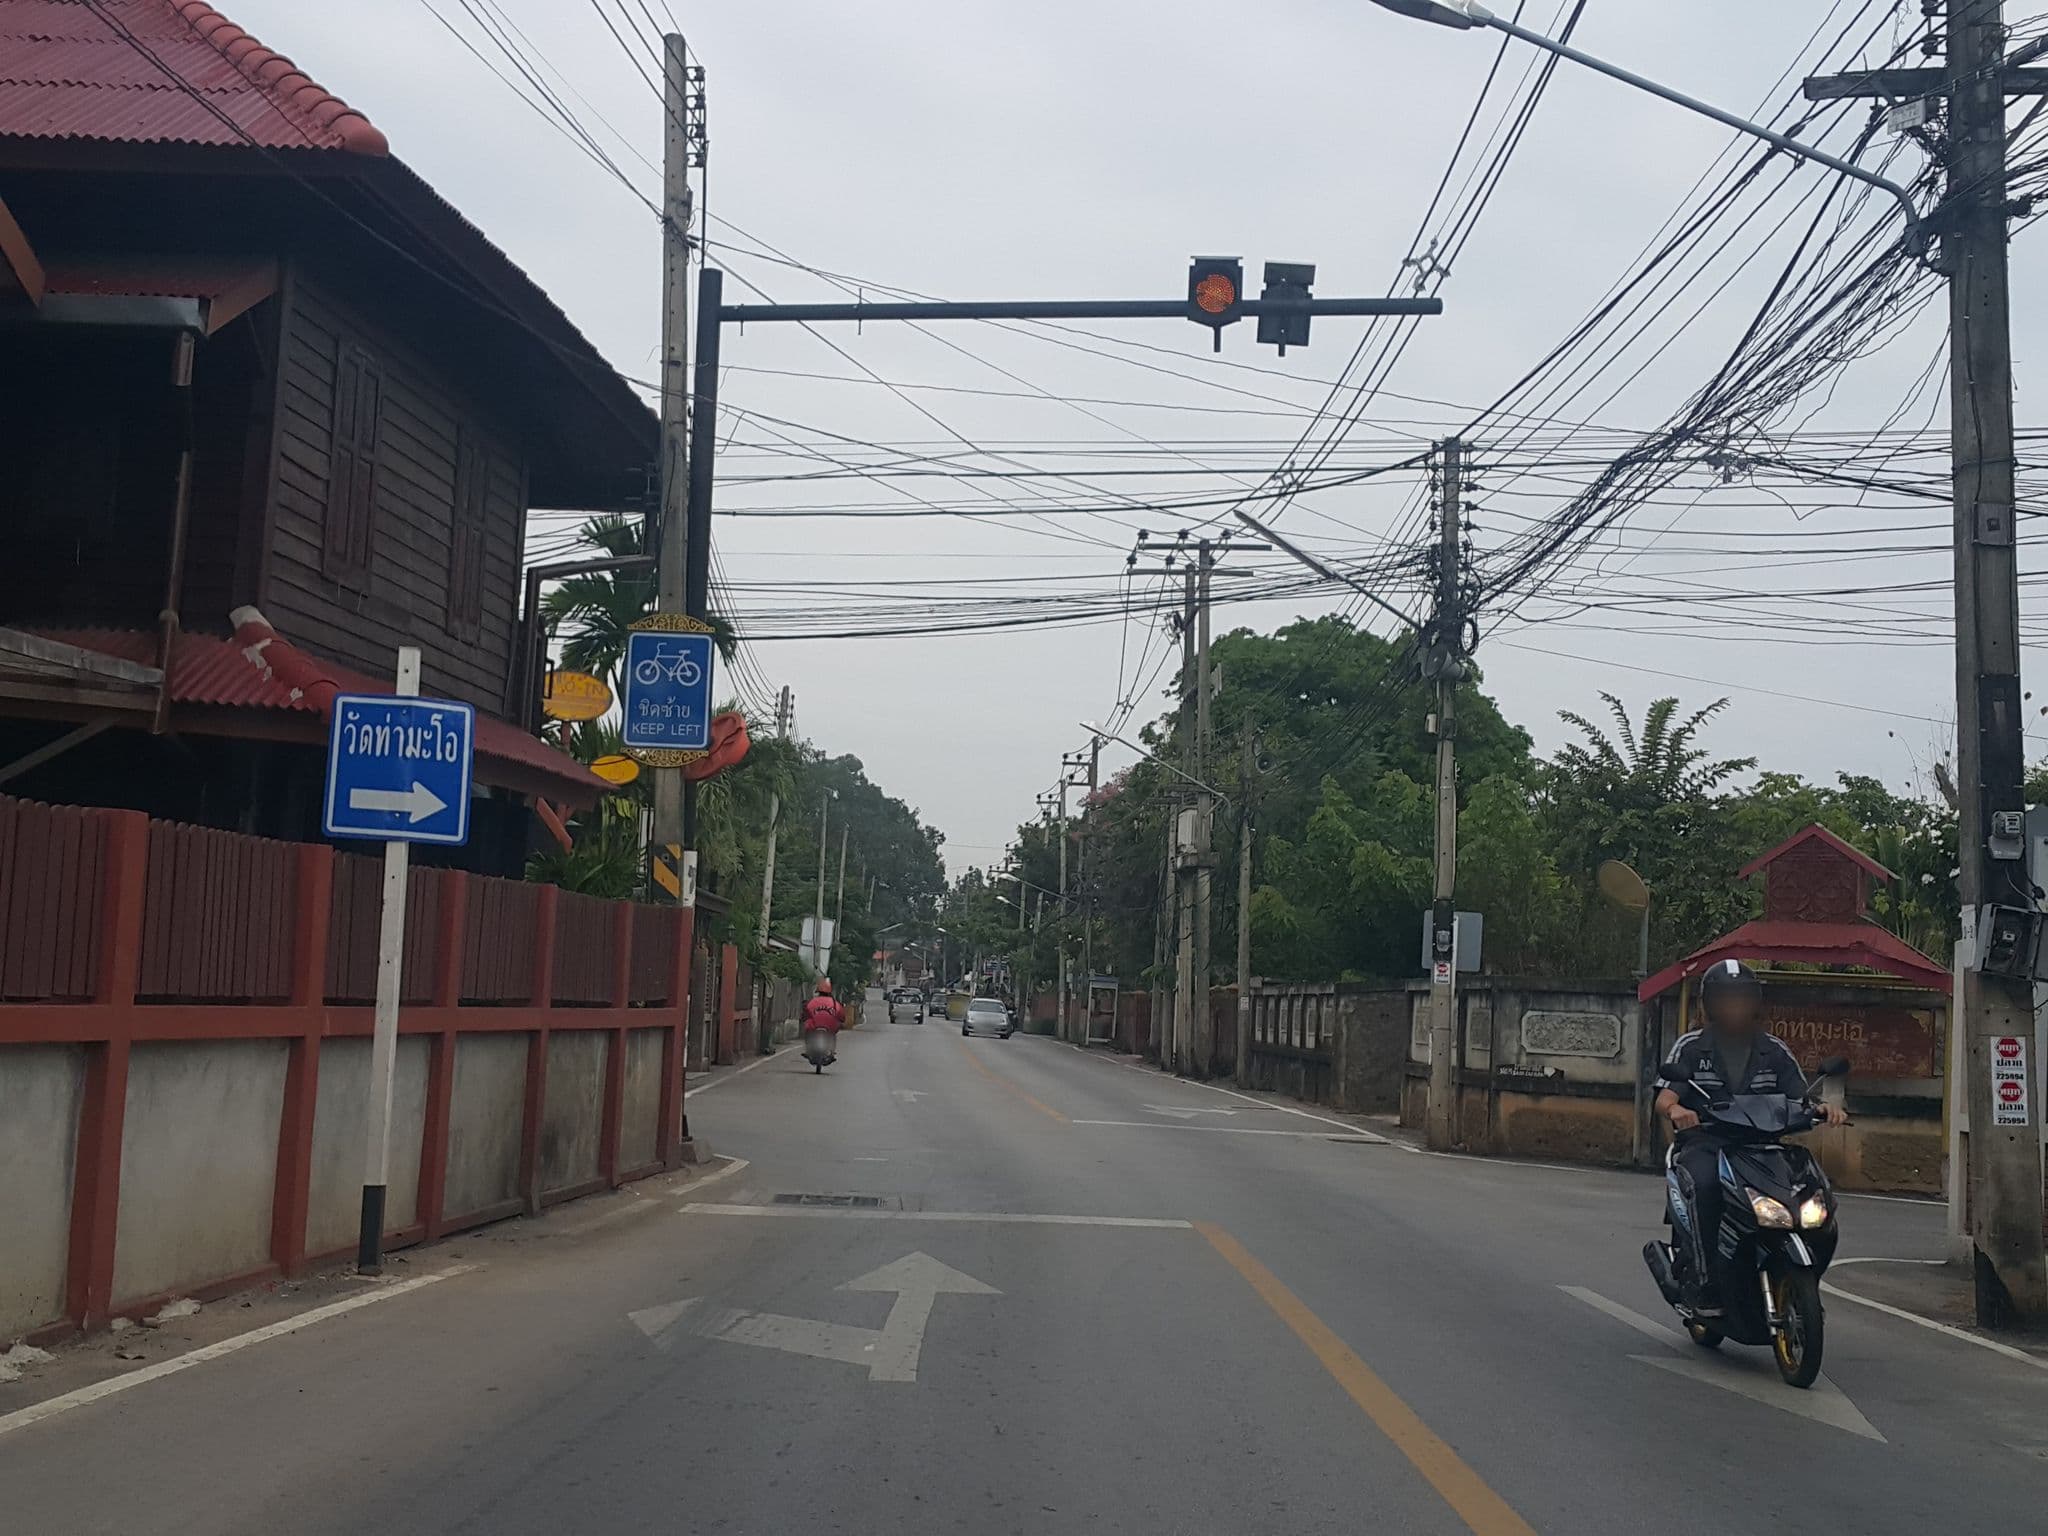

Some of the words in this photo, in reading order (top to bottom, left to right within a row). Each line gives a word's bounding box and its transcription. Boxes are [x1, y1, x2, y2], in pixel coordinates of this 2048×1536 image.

[639, 696, 690, 718] ชิดซ้าย
[344, 711, 458, 762] วัดท่ามะโอ
[632, 722, 665, 735] KEEP
[671, 724, 702, 736] LEFT
